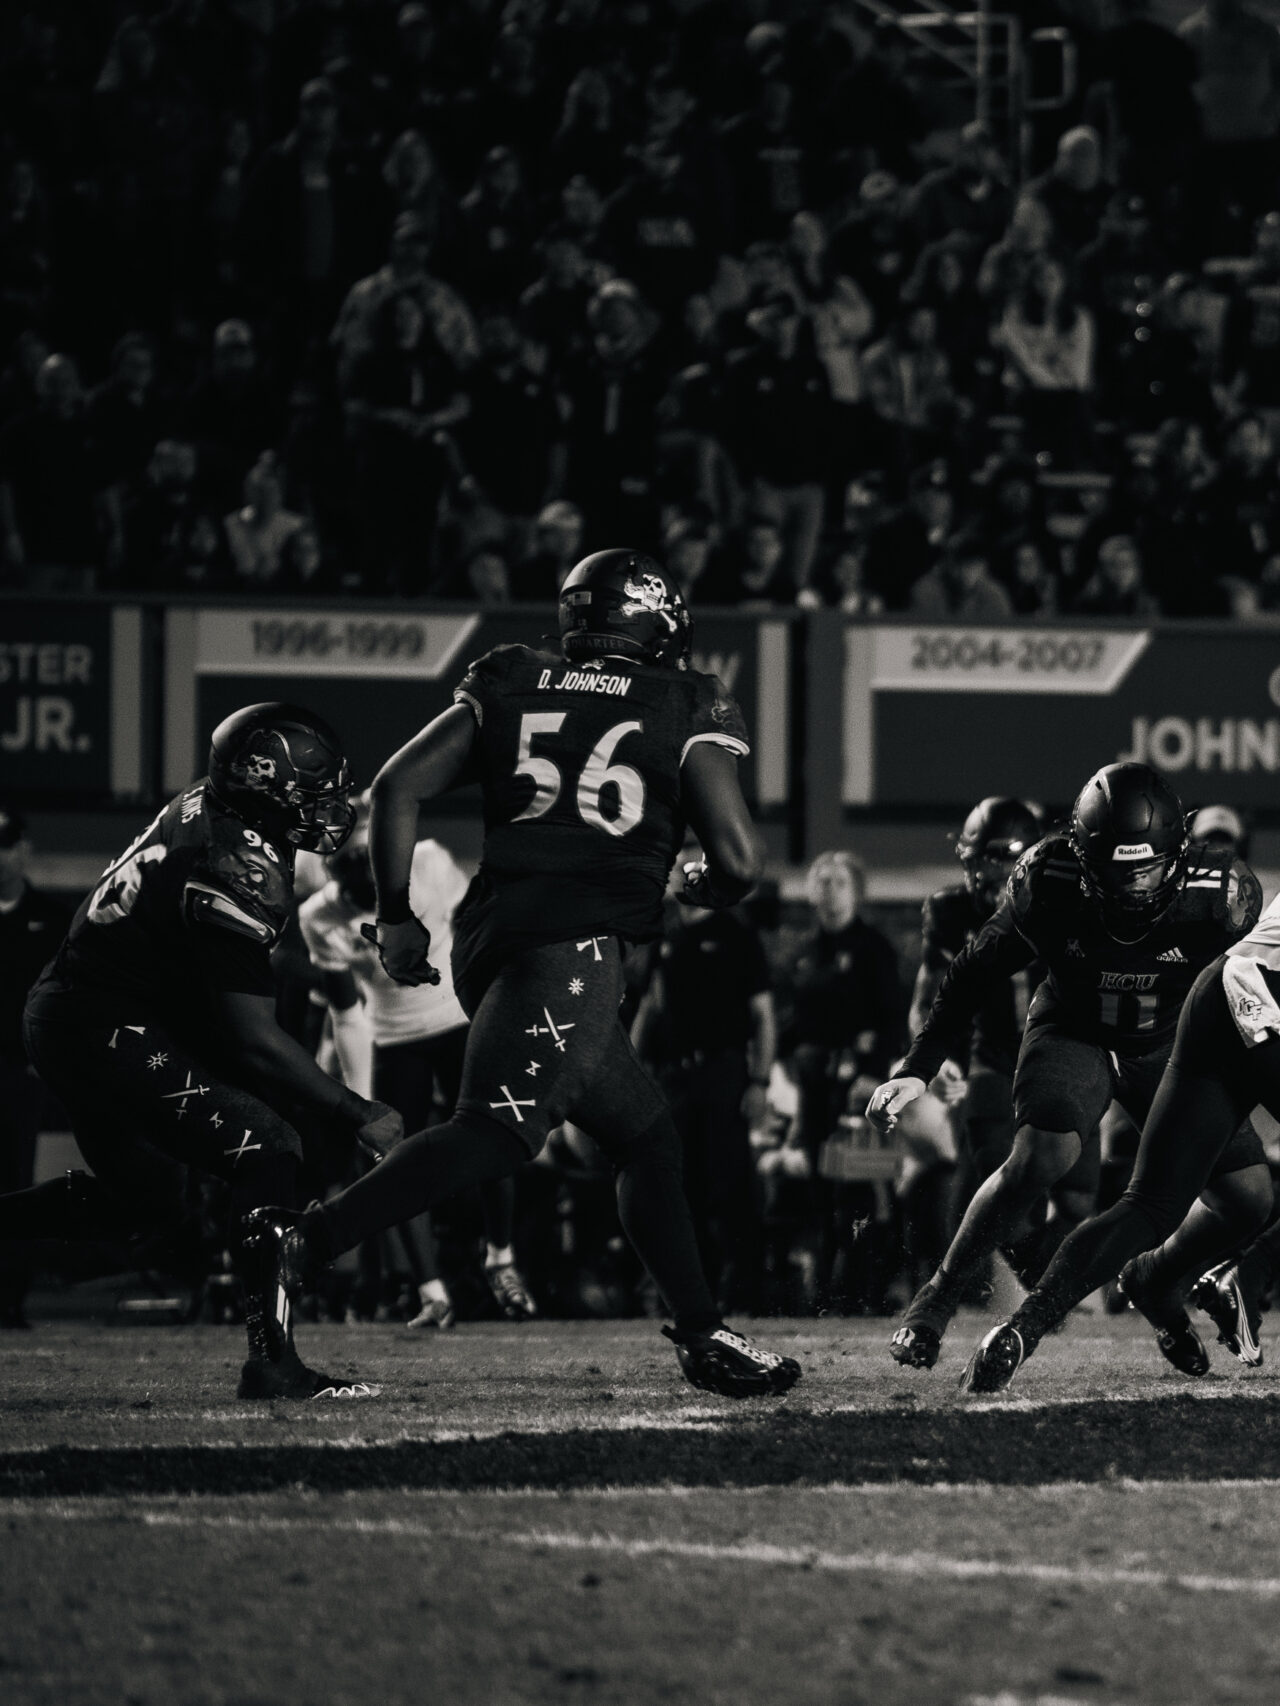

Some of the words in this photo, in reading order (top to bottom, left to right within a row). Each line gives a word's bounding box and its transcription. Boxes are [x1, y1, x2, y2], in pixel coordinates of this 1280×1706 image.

[251, 619, 426, 657] 1996-1999
[912, 634, 1104, 672] 2004-2007
[536, 668, 551, 690] D.
[555, 671, 632, 697] JOHNSON
[1, 696, 92, 752] JR.
[508, 711, 647, 837] 56
[242, 828, 280, 865] 96
[1117, 846, 1149, 856] Riddell
[1155, 954, 1190, 964] adidas
[1097, 970, 1161, 992] ECU
[1098, 992, 1160, 1031] 11
